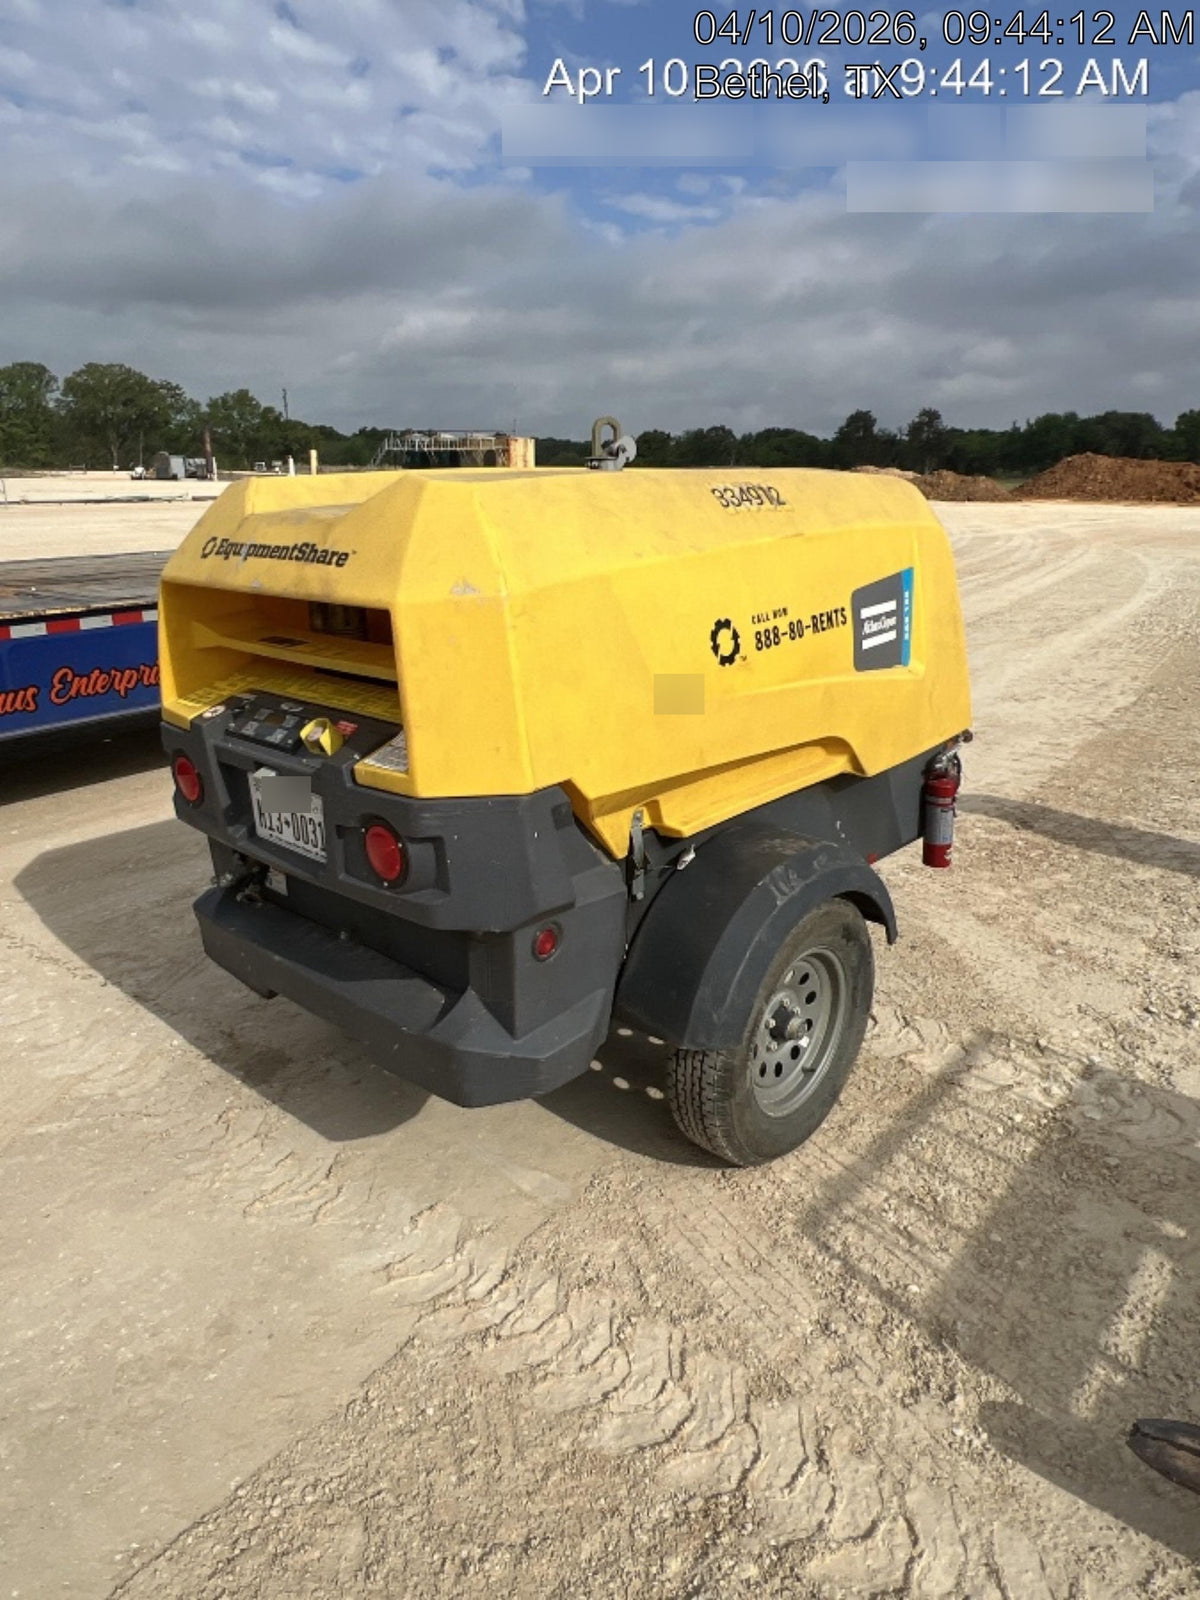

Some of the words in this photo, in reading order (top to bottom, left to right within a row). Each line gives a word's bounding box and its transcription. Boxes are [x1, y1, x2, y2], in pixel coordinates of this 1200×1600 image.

[214, 538, 349, 567] EqupmentShare
[755, 607, 847, 651] 888-80-RENTS
[50, 660, 160, 706] Enterpri
